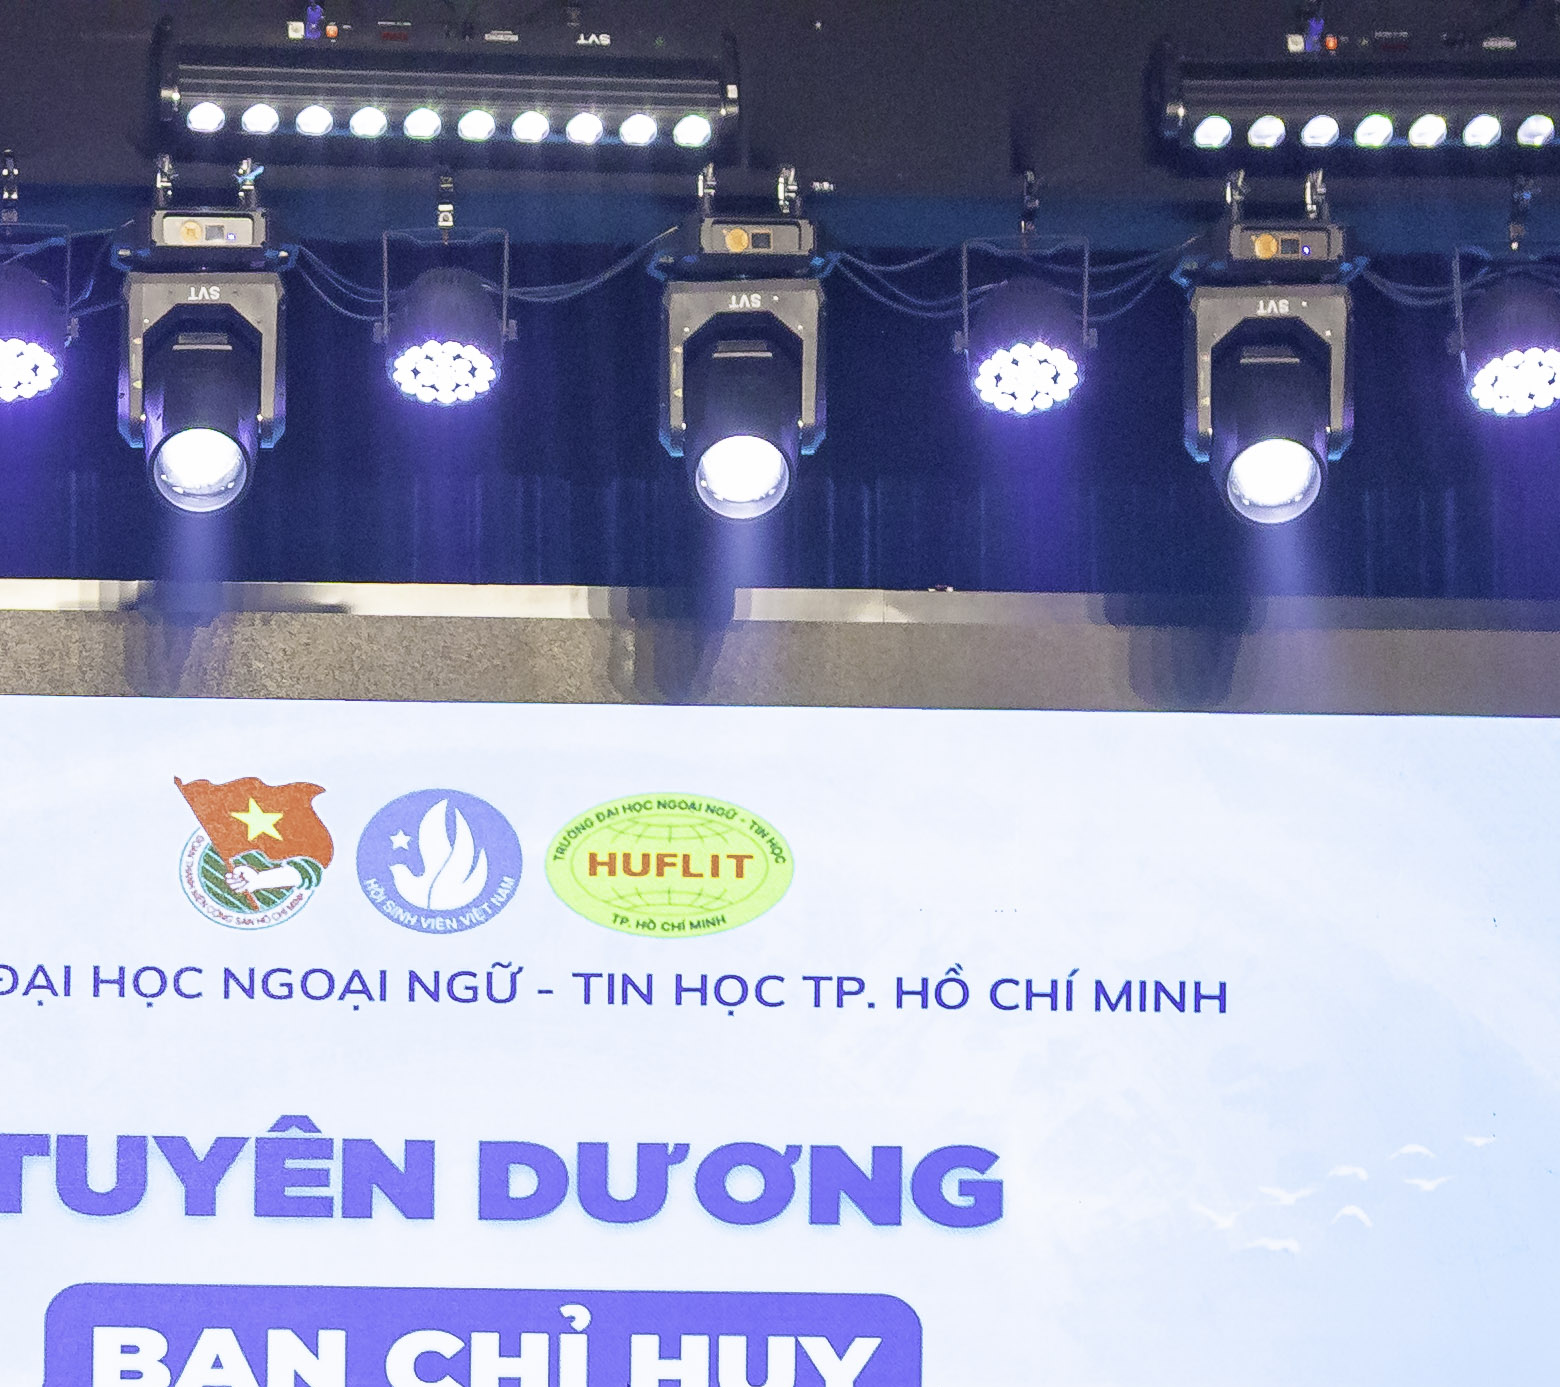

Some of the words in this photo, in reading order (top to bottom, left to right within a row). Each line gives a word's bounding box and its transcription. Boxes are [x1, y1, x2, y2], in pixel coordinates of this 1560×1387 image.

[188, 285, 221, 301] SVT
[748, 819, 769, 839] TIN
[588, 852, 754, 879] HUFLIT
[382, 900, 418, 926] SINH
[490, 875, 516, 907] NAM
[689, 914, 727, 932] MINH
[93, 966, 202, 1007] HỌC
[224, 968, 386, 1011] NGOẠI
[409, 962, 523, 1004] NGỮ
[572, 972, 653, 1006] TIN
[675, 974, 785, 1016] HỌC
[802, 975, 876, 1009] TP.
[896, 963, 969, 1010] HỒ
[990, 968, 1080, 1012] CHÍ
[1094, 979, 1227, 1014] MINH
[477, 1138, 1004, 1229] DƯƠNG
